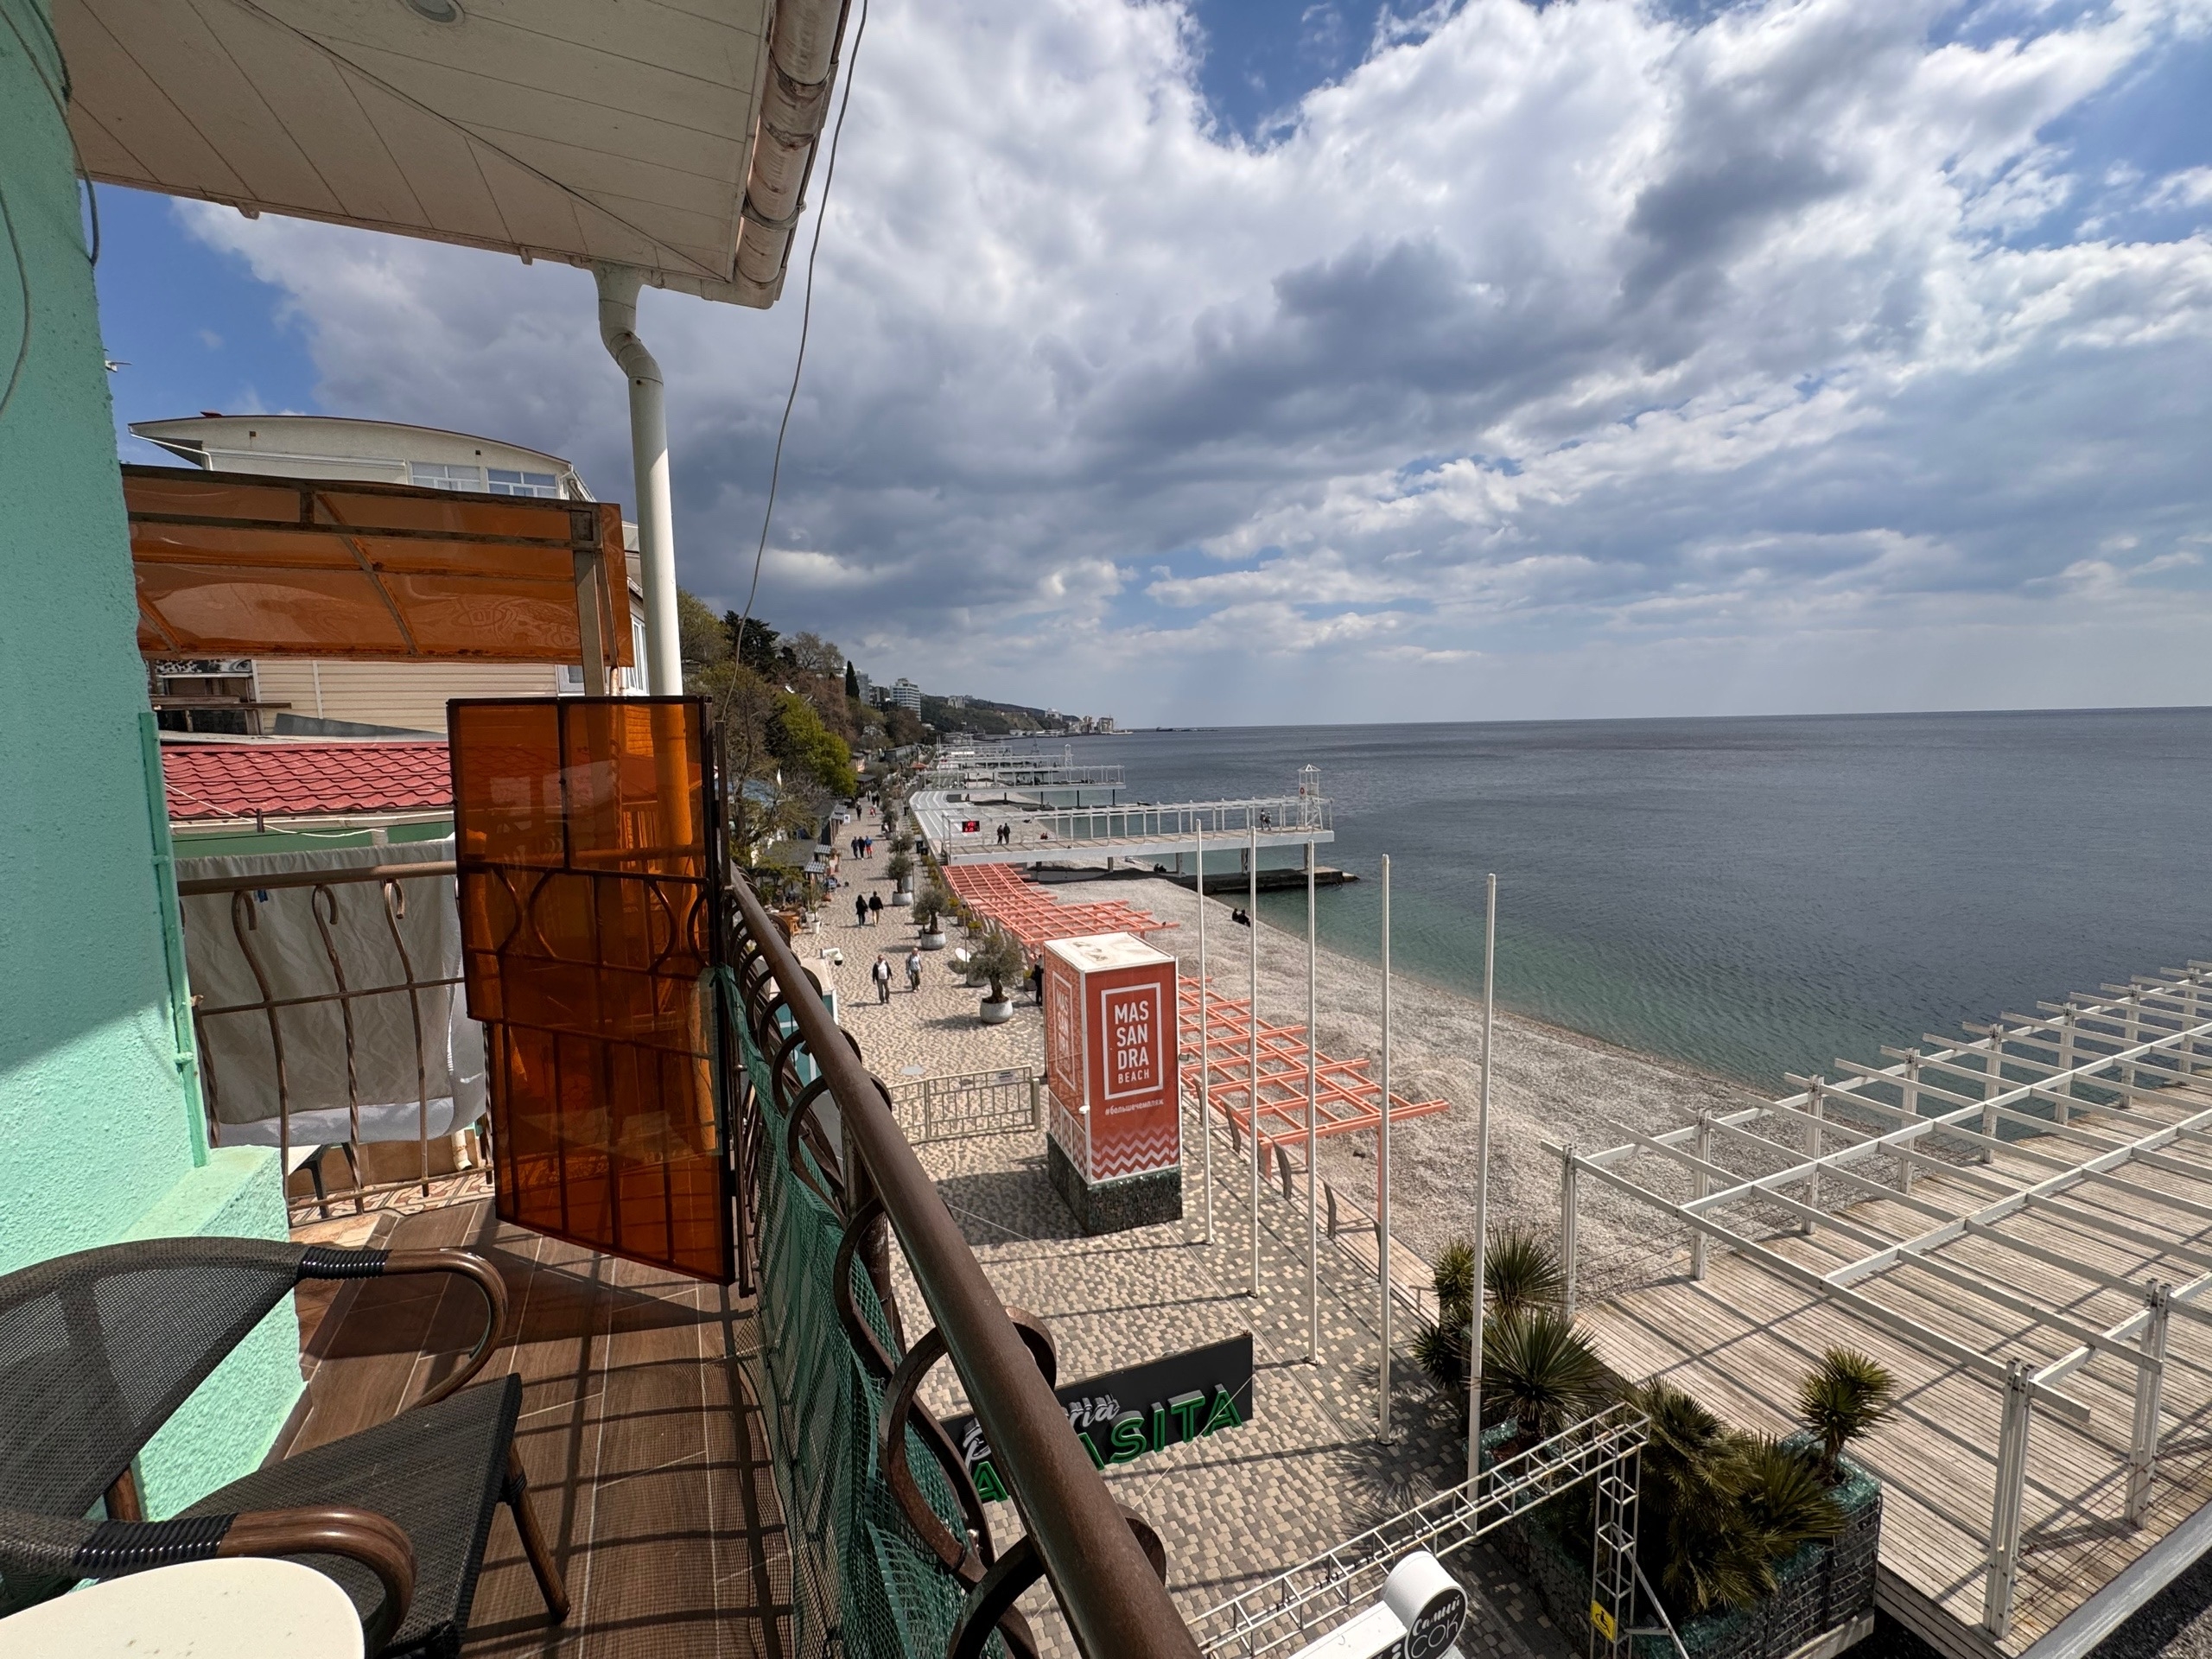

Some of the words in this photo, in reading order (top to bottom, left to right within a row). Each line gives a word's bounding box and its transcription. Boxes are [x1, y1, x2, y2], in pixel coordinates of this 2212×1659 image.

[1114, 1001, 1149, 1025] MAS
[1116, 1023, 1148, 1047] SAN
[1117, 1046, 1149, 1071] DRA
[1118, 1069, 1150, 1084] BEACH
